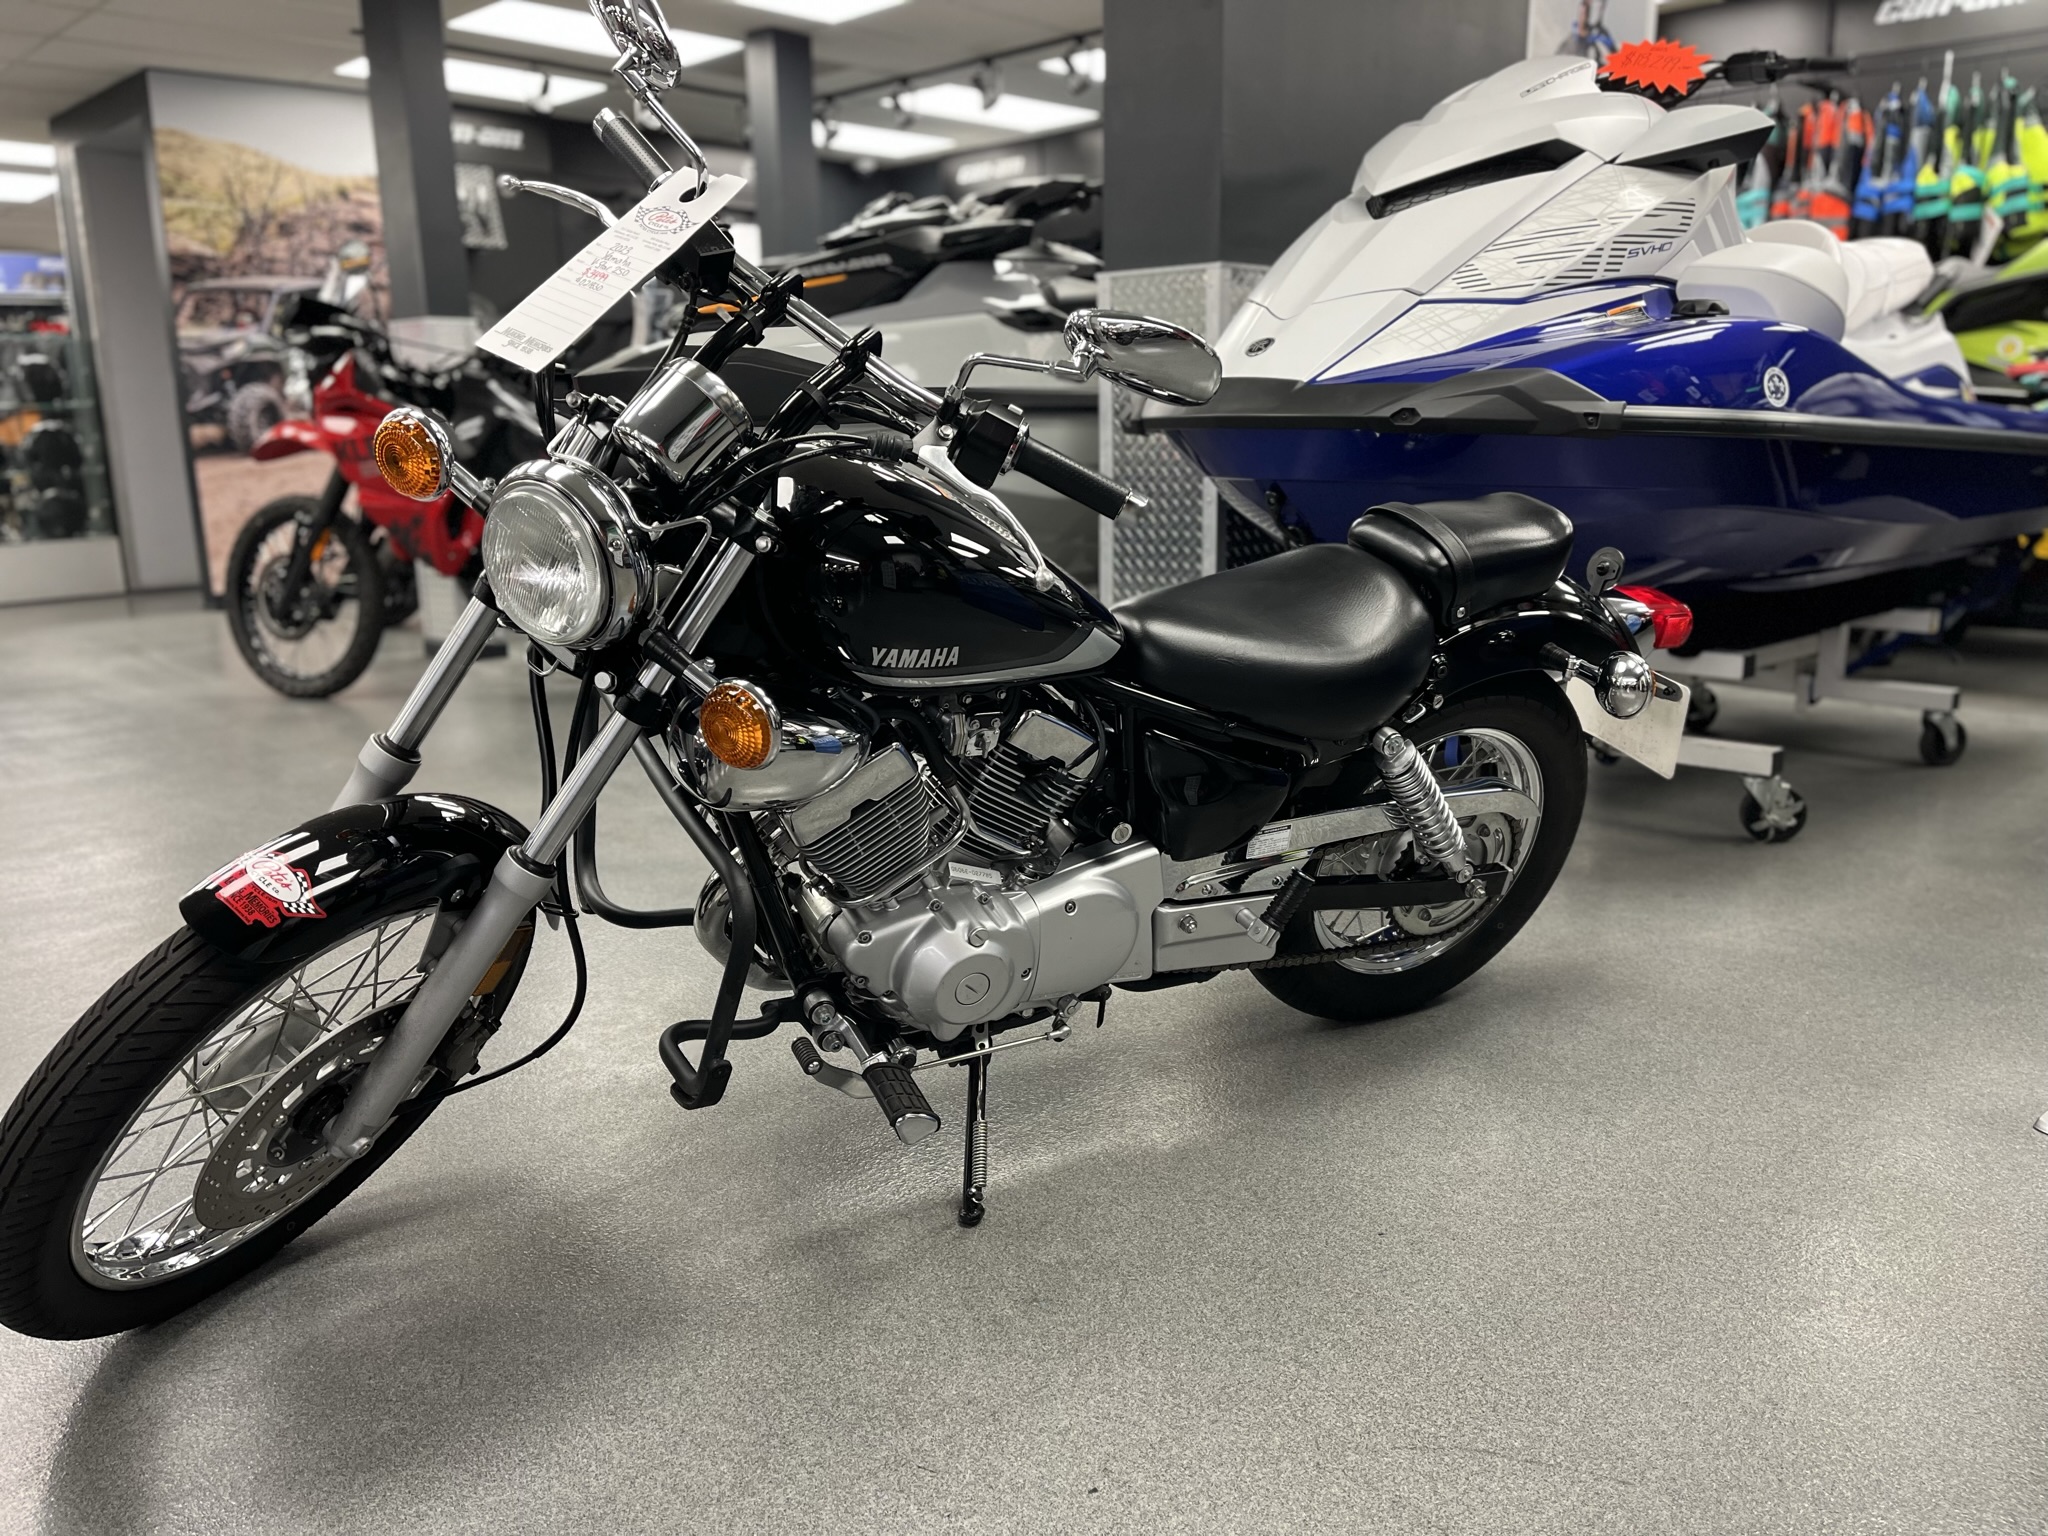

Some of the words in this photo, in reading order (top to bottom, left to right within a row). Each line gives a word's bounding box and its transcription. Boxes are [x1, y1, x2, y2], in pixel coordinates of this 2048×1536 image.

[609, 242, 634, 256] 2023
[1626, 241, 1674, 259] SVHO
[871, 646, 960, 669] YAMAHA
[240, 900, 256, 917] 1938
[245, 891, 278, 925] MEMORIES
